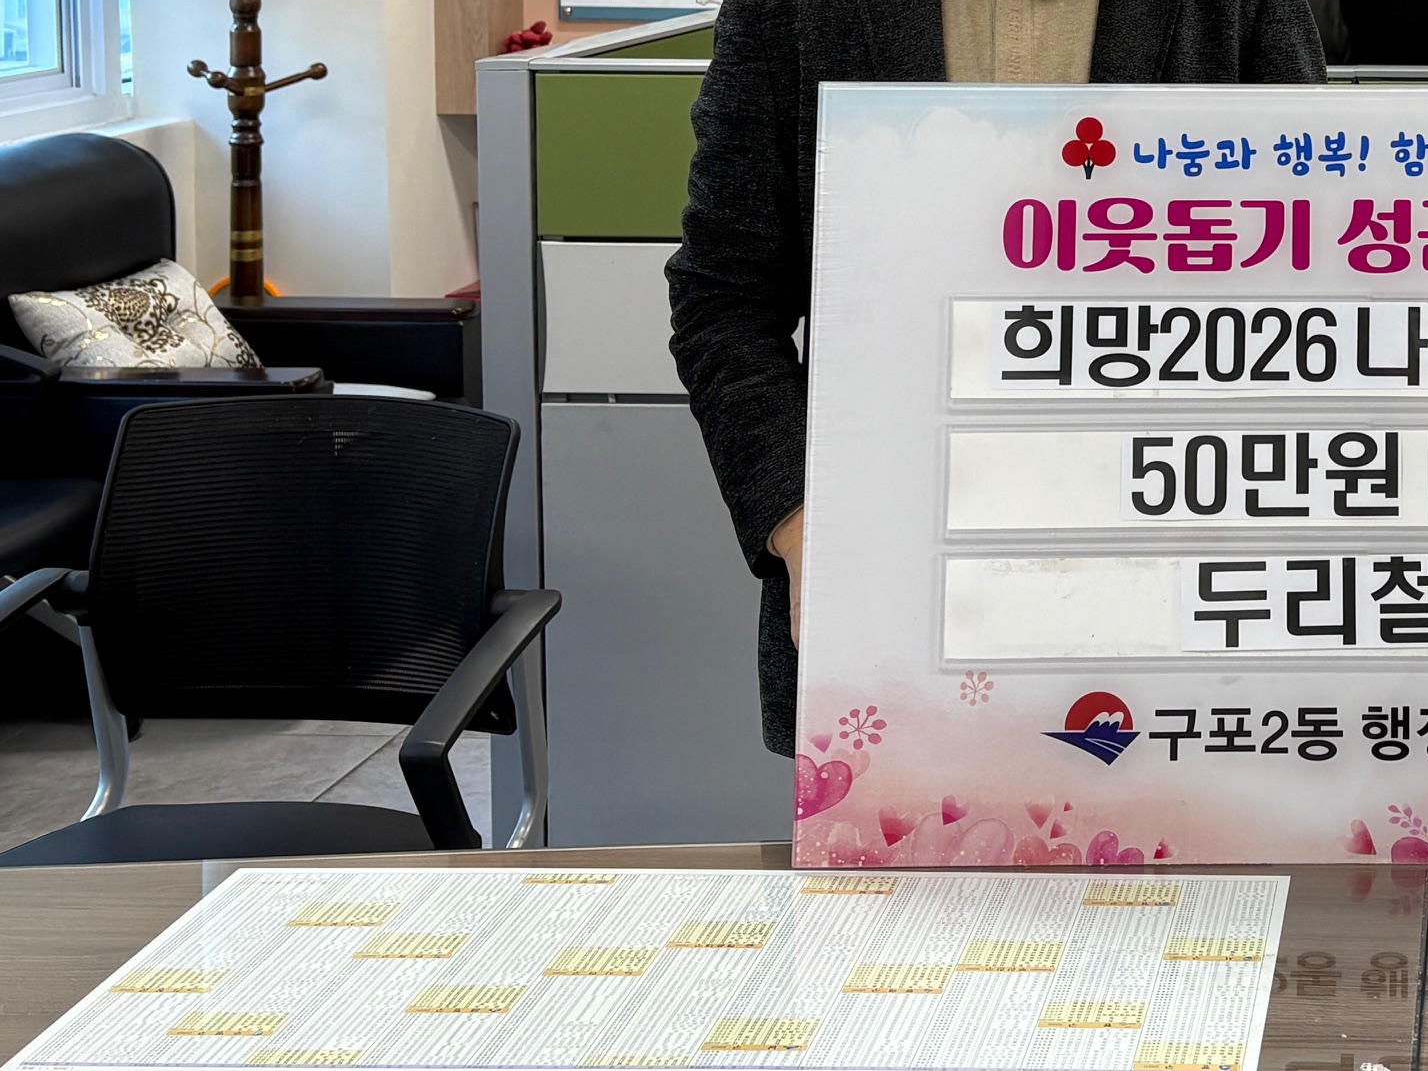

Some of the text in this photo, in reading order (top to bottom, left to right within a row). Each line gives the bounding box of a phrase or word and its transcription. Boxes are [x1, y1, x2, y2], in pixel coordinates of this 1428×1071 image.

[1132, 137, 1257, 178] 나눔과
[1273, 134, 1369, 178] 행복!
[1002, 195, 1311, 274] 이웃돕기
[1001, 303, 1338, 388] 희망2026
[1131, 430, 1400, 519] 50만원
[1147, 706, 1344, 763] 구포2동
